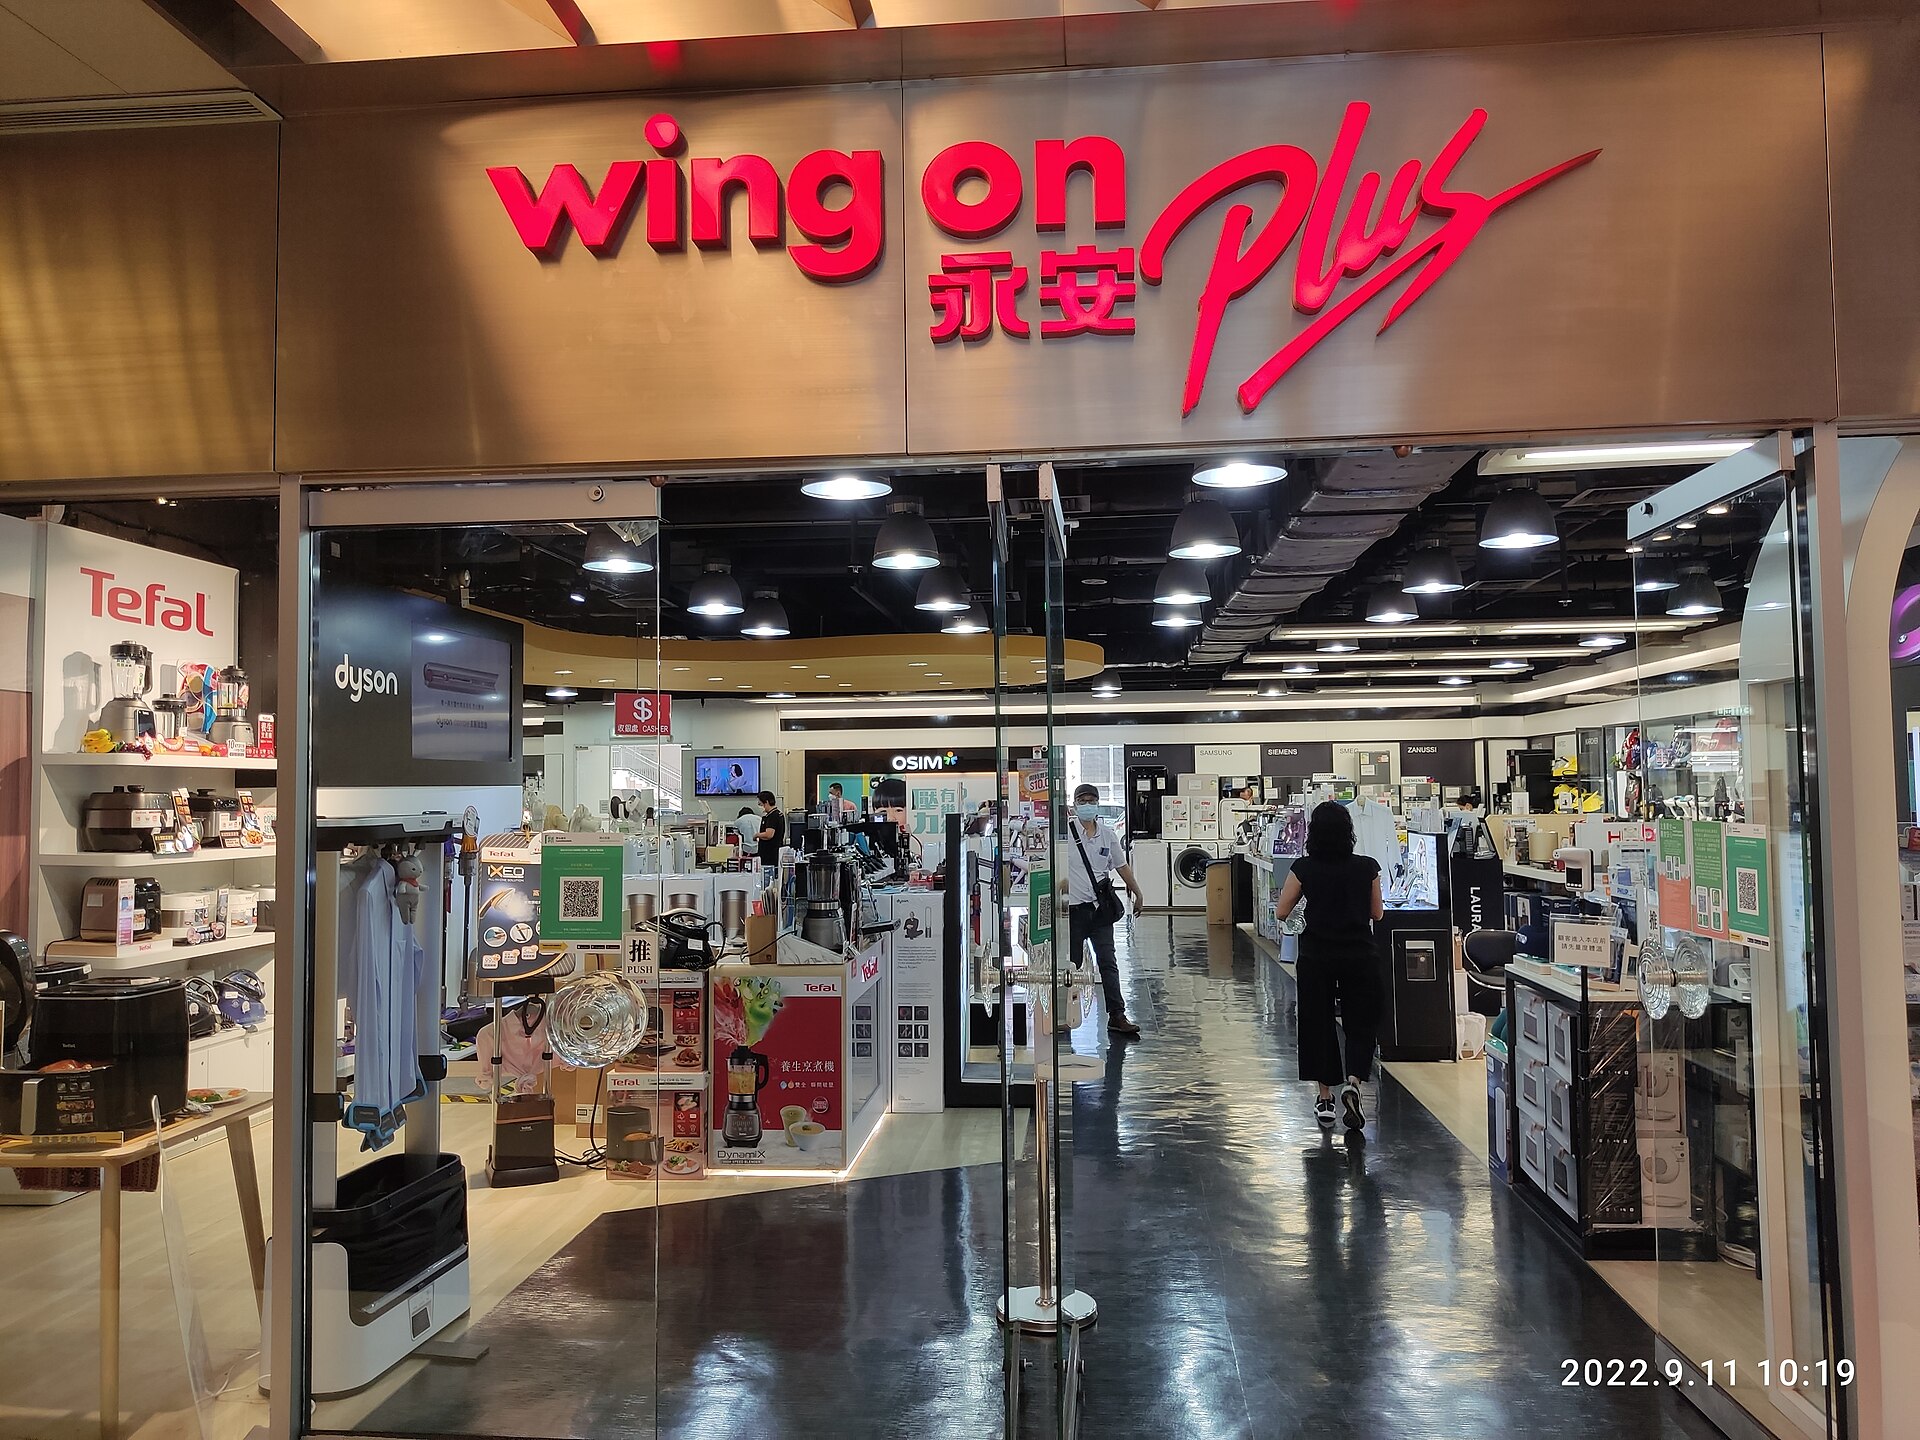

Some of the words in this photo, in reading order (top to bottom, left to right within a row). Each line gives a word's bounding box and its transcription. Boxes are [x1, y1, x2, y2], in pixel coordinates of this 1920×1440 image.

[486, 113, 885, 283] wing
[922, 136, 1126, 240] on
[1140, 102, 1603, 420] Plus
[928, 245, 1137, 344] 永安
[79, 566, 214, 638] Tefal
[334, 653, 399, 703] dyson
[642, 725, 669, 733] CASHER
[1199, 749, 1233, 757] SAMSUNG
[1267, 748, 1298, 756] SIEMENS
[1407, 746, 1438, 754] ZANUSSI
[892, 755, 943, 771] OSIM
[912, 788, 939, 834] 壓力
[488, 850, 516, 858] Tefal
[628, 939, 651, 962] 推
[627, 965, 653, 974] PUSH
[804, 983, 838, 992] Tefal
[611, 1078, 640, 1086] Tefal
[717, 1150, 766, 1160] DynamiX
